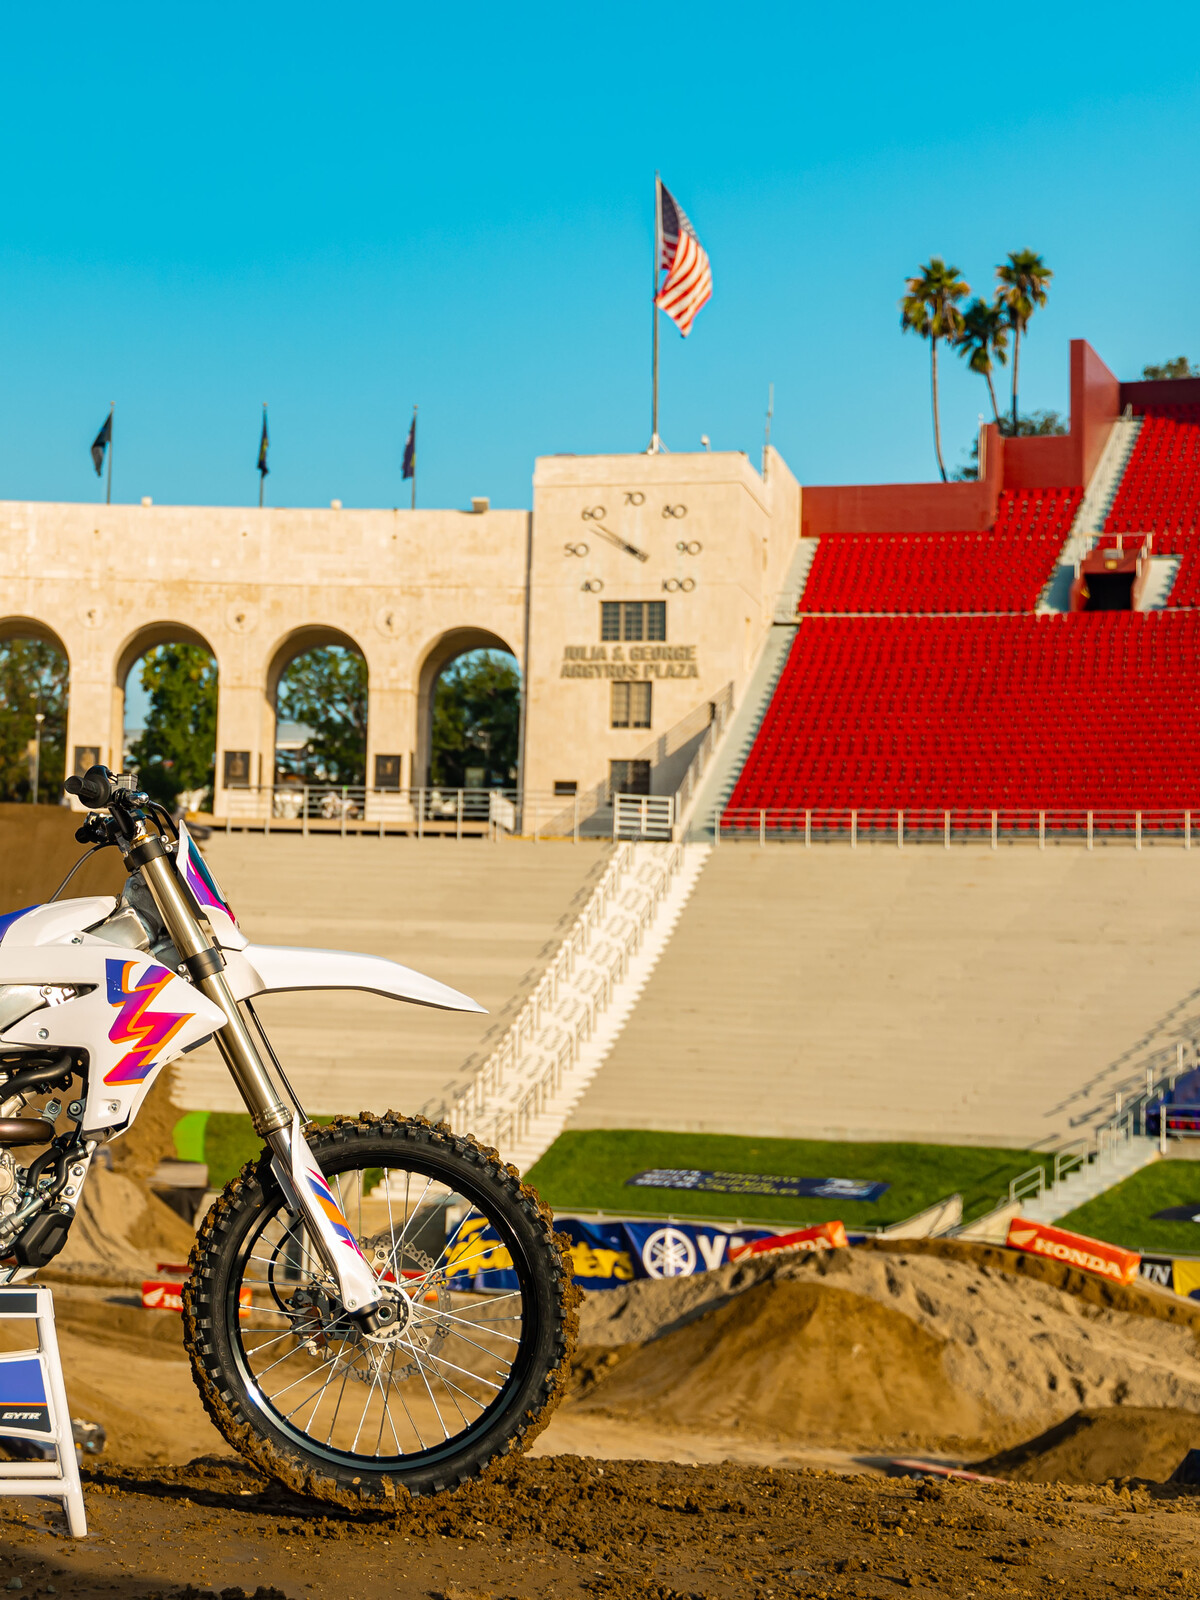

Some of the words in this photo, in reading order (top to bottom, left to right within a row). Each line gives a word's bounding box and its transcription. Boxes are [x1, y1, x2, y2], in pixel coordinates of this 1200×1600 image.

[623, 491, 646, 506] 70
[581, 505, 606, 521] 60
[661, 504, 688, 519] 80
[564, 542, 589, 558] 50
[676, 541, 703, 556] 90
[580, 579, 604, 593] 40
[661, 578, 696, 593] 100
[563, 645, 607, 660] JULIA
[629, 645, 697, 660] GEORGE
[643, 664, 699, 679] PLAZA
[1034, 1237, 1123, 1279] HONDA
[2, 1412, 42, 1420] GYTR
